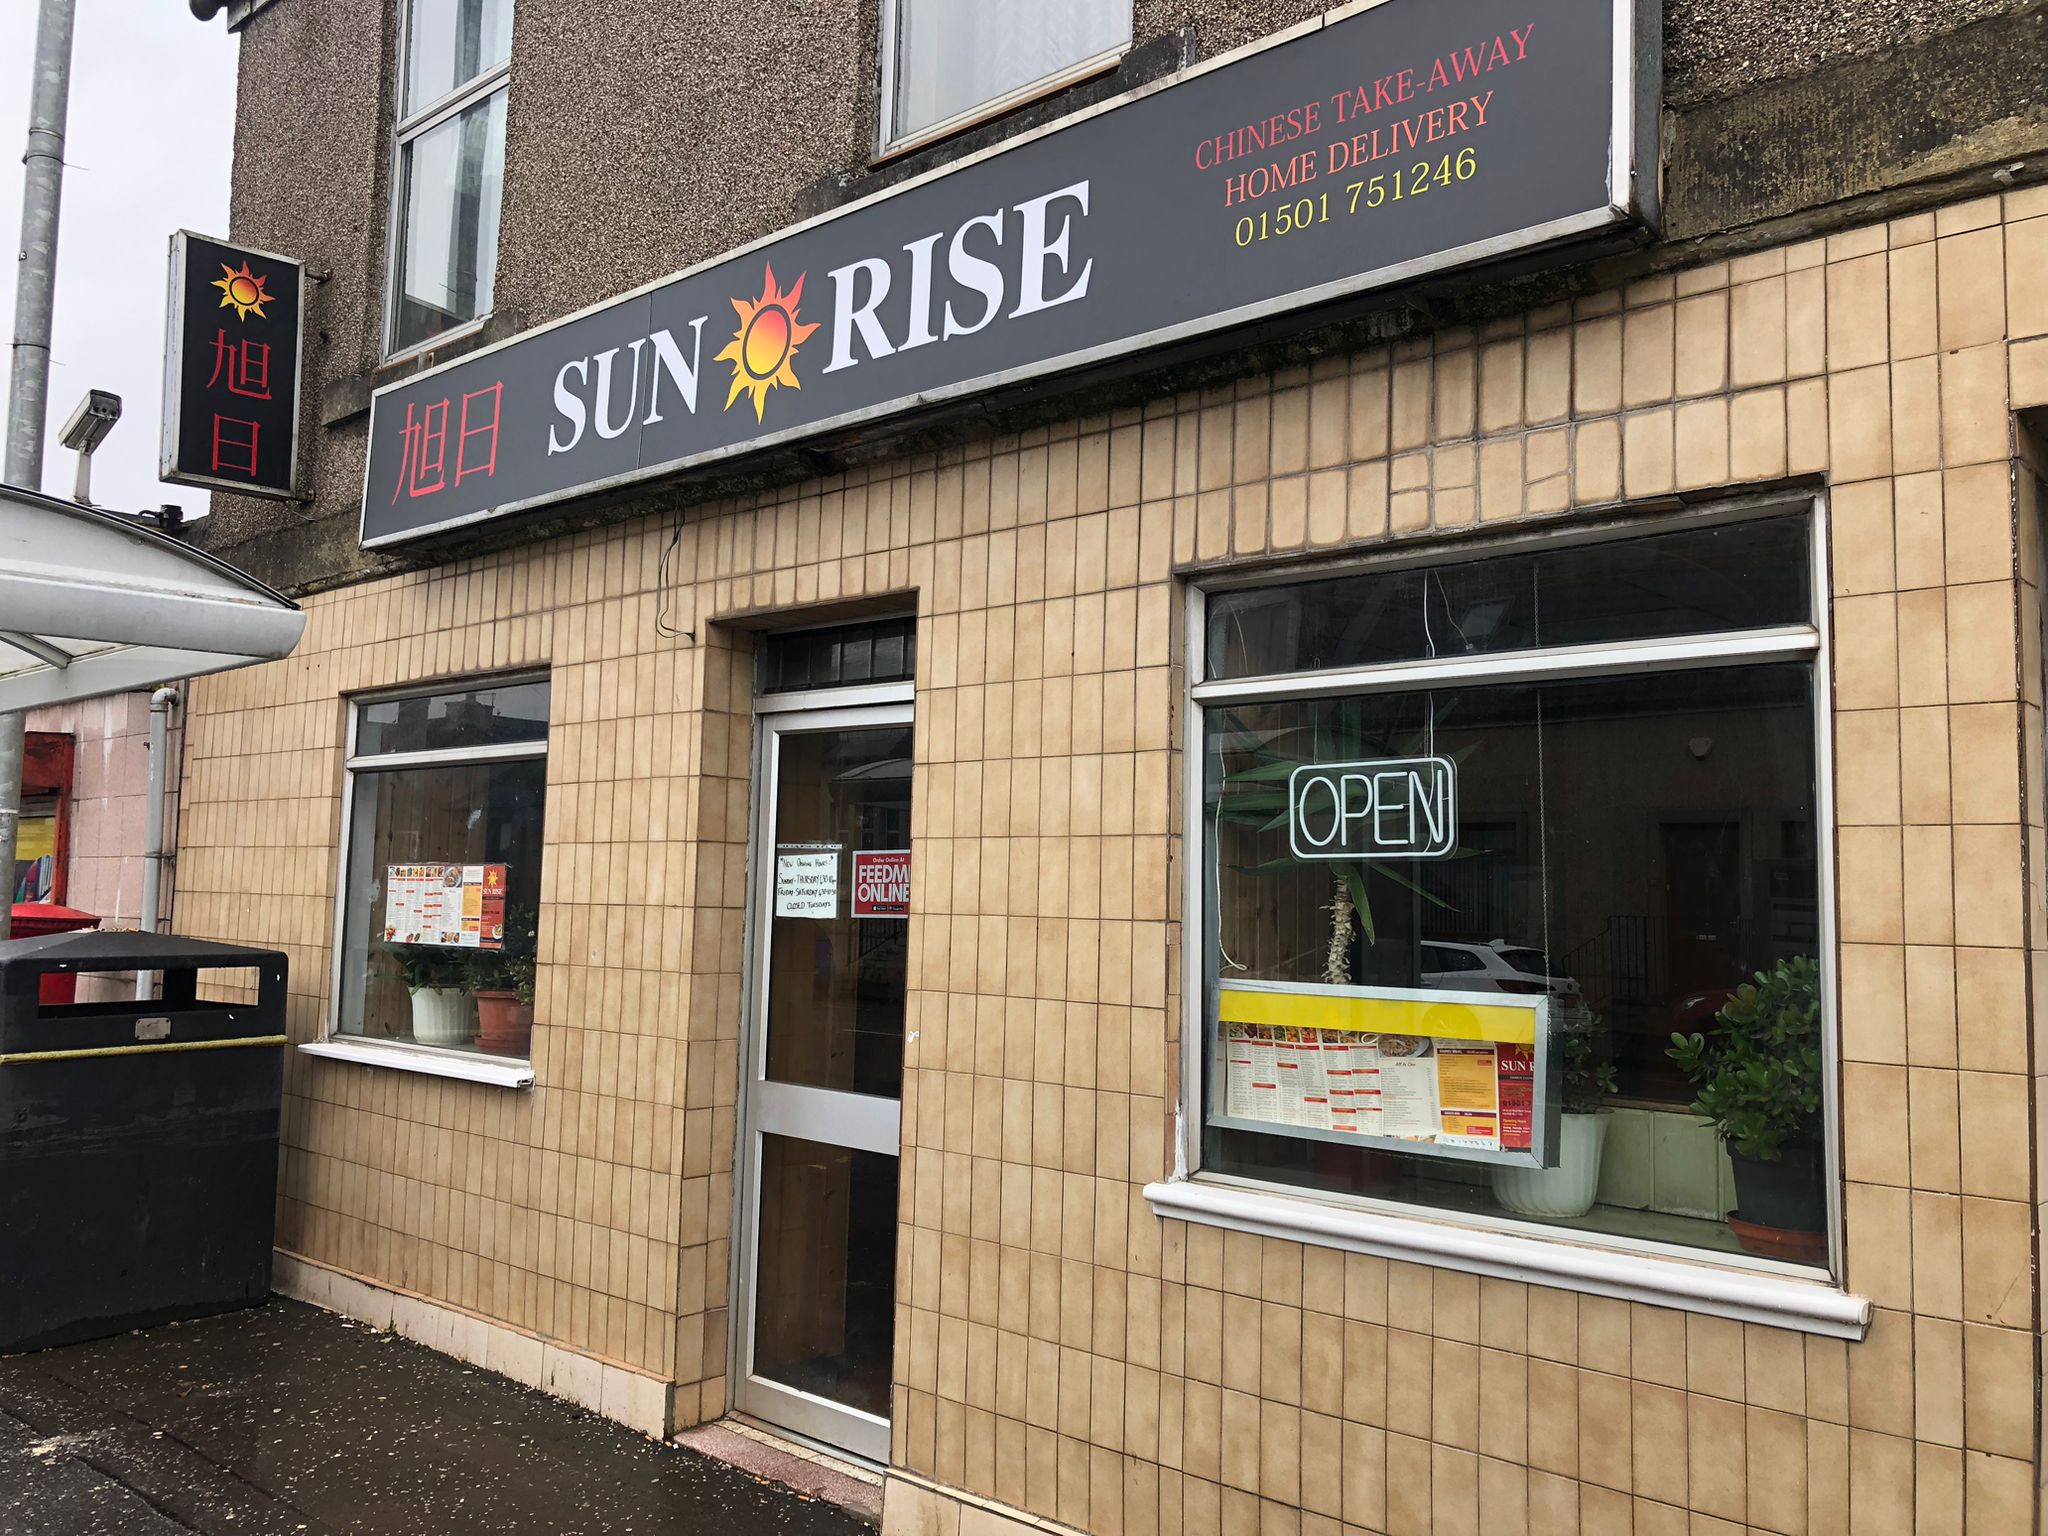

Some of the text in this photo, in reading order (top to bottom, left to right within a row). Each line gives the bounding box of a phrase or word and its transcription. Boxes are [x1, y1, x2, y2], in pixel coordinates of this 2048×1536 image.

[1195, 23, 1534, 170] CHINESE TAKE-AWAY
[1223, 90, 1494, 207] HOME DELIVERY
[1234, 147, 1477, 247] 01501 751246
[547, 179, 1094, 456] SUN RISE
[206, 328, 272, 477] 旭日
[391, 380, 504, 507] 旭日
[1299, 769, 1443, 846] OPEN
[858, 883, 909, 902] ONLINE
[859, 864, 910, 884] FEEDM
[1501, 1060, 1526, 1072] SUN
